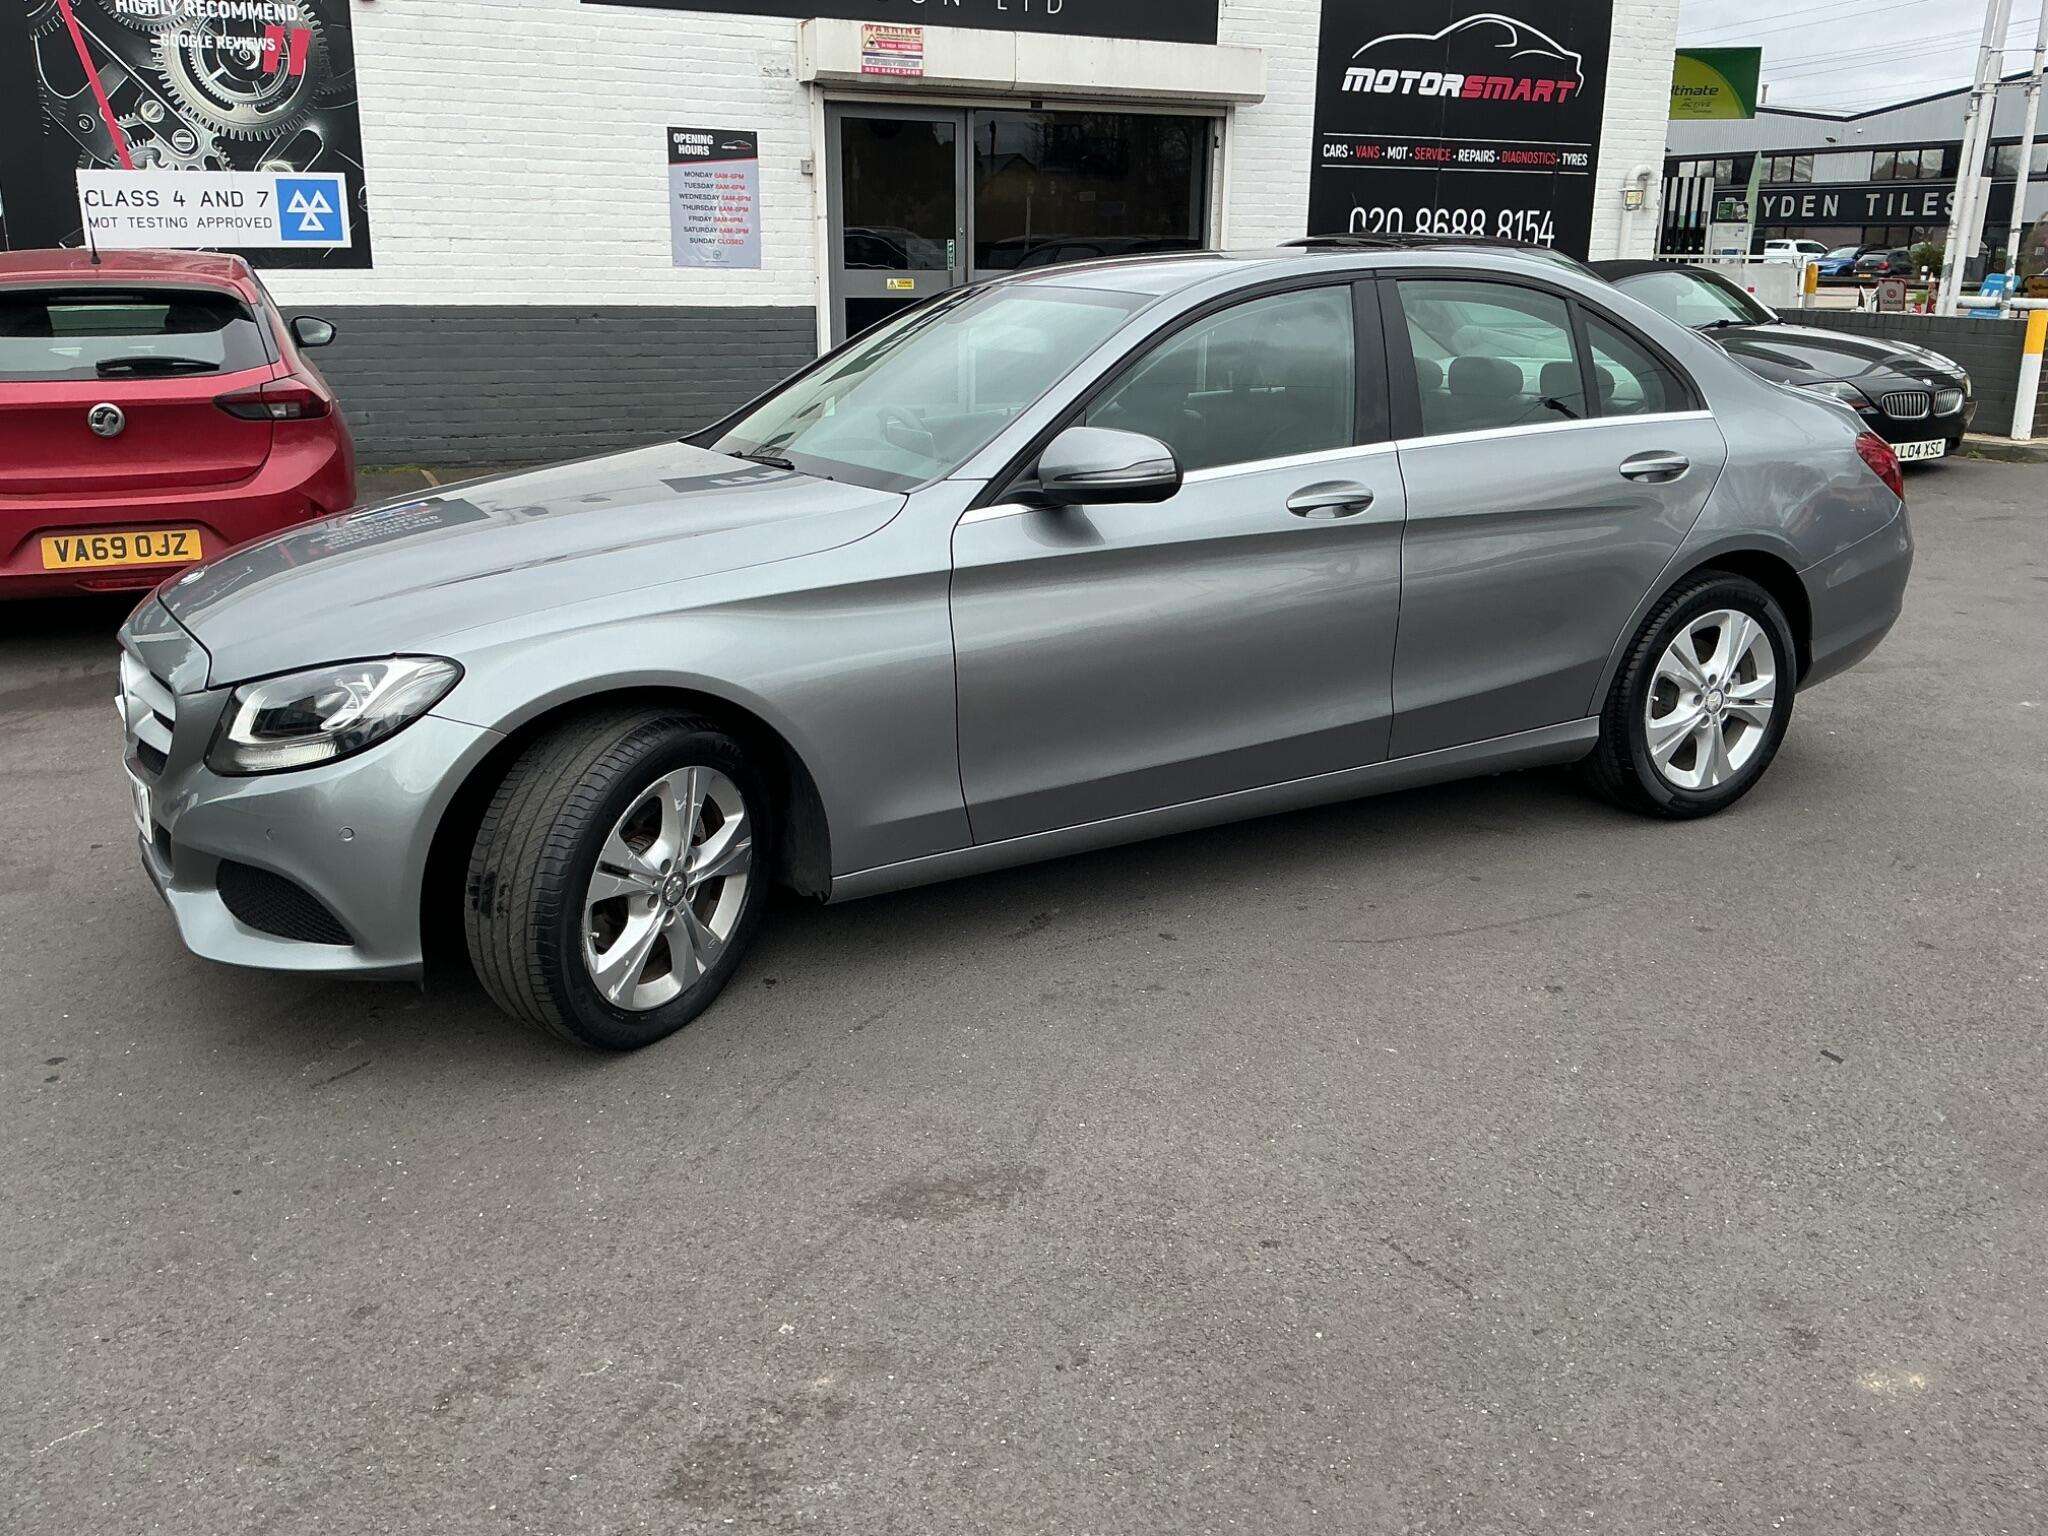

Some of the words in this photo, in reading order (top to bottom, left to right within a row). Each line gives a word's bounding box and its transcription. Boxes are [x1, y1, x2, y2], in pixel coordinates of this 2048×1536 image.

[115, 0, 179, 15] HIGHLY
[864, 24, 921, 35] WARNING
[161, 34, 213, 49] GOOGLE
[216, 36, 276, 51] REVIEWS
[1671, 85, 1719, 96] ltimate
[673, 133, 714, 145] OPENING
[678, 144, 710, 156] HOURS
[1323, 144, 1348, 158] CARS
[1355, 144, 1380, 159] VANS
[1387, 146, 1408, 160] MOT
[1414, 147, 1451, 161] SERVICE
[1458, 149, 1495, 163] REPAIRS
[1501, 151, 1556, 165] DIAGNOSTICS
[1562, 153, 1587, 166] TYRES
[85, 189, 160, 207] CLASS
[173, 190, 186, 207] 4
[200, 190, 244, 207] AND
[257, 191, 270, 207] 7
[1866, 191, 1955, 216] TILES
[88, 216, 118, 229] MOT
[128, 217, 188, 229] TESTING
[197, 217, 272, 229] APPROVED
[1350, 207, 1403, 233] 020
[1415, 208, 1486, 236] 8688
[1496, 209, 1555, 248] 8154
[1924, 441, 1942, 456] XSC
[54, 537, 127, 562] VA69
[135, 533, 189, 557] OJZ
